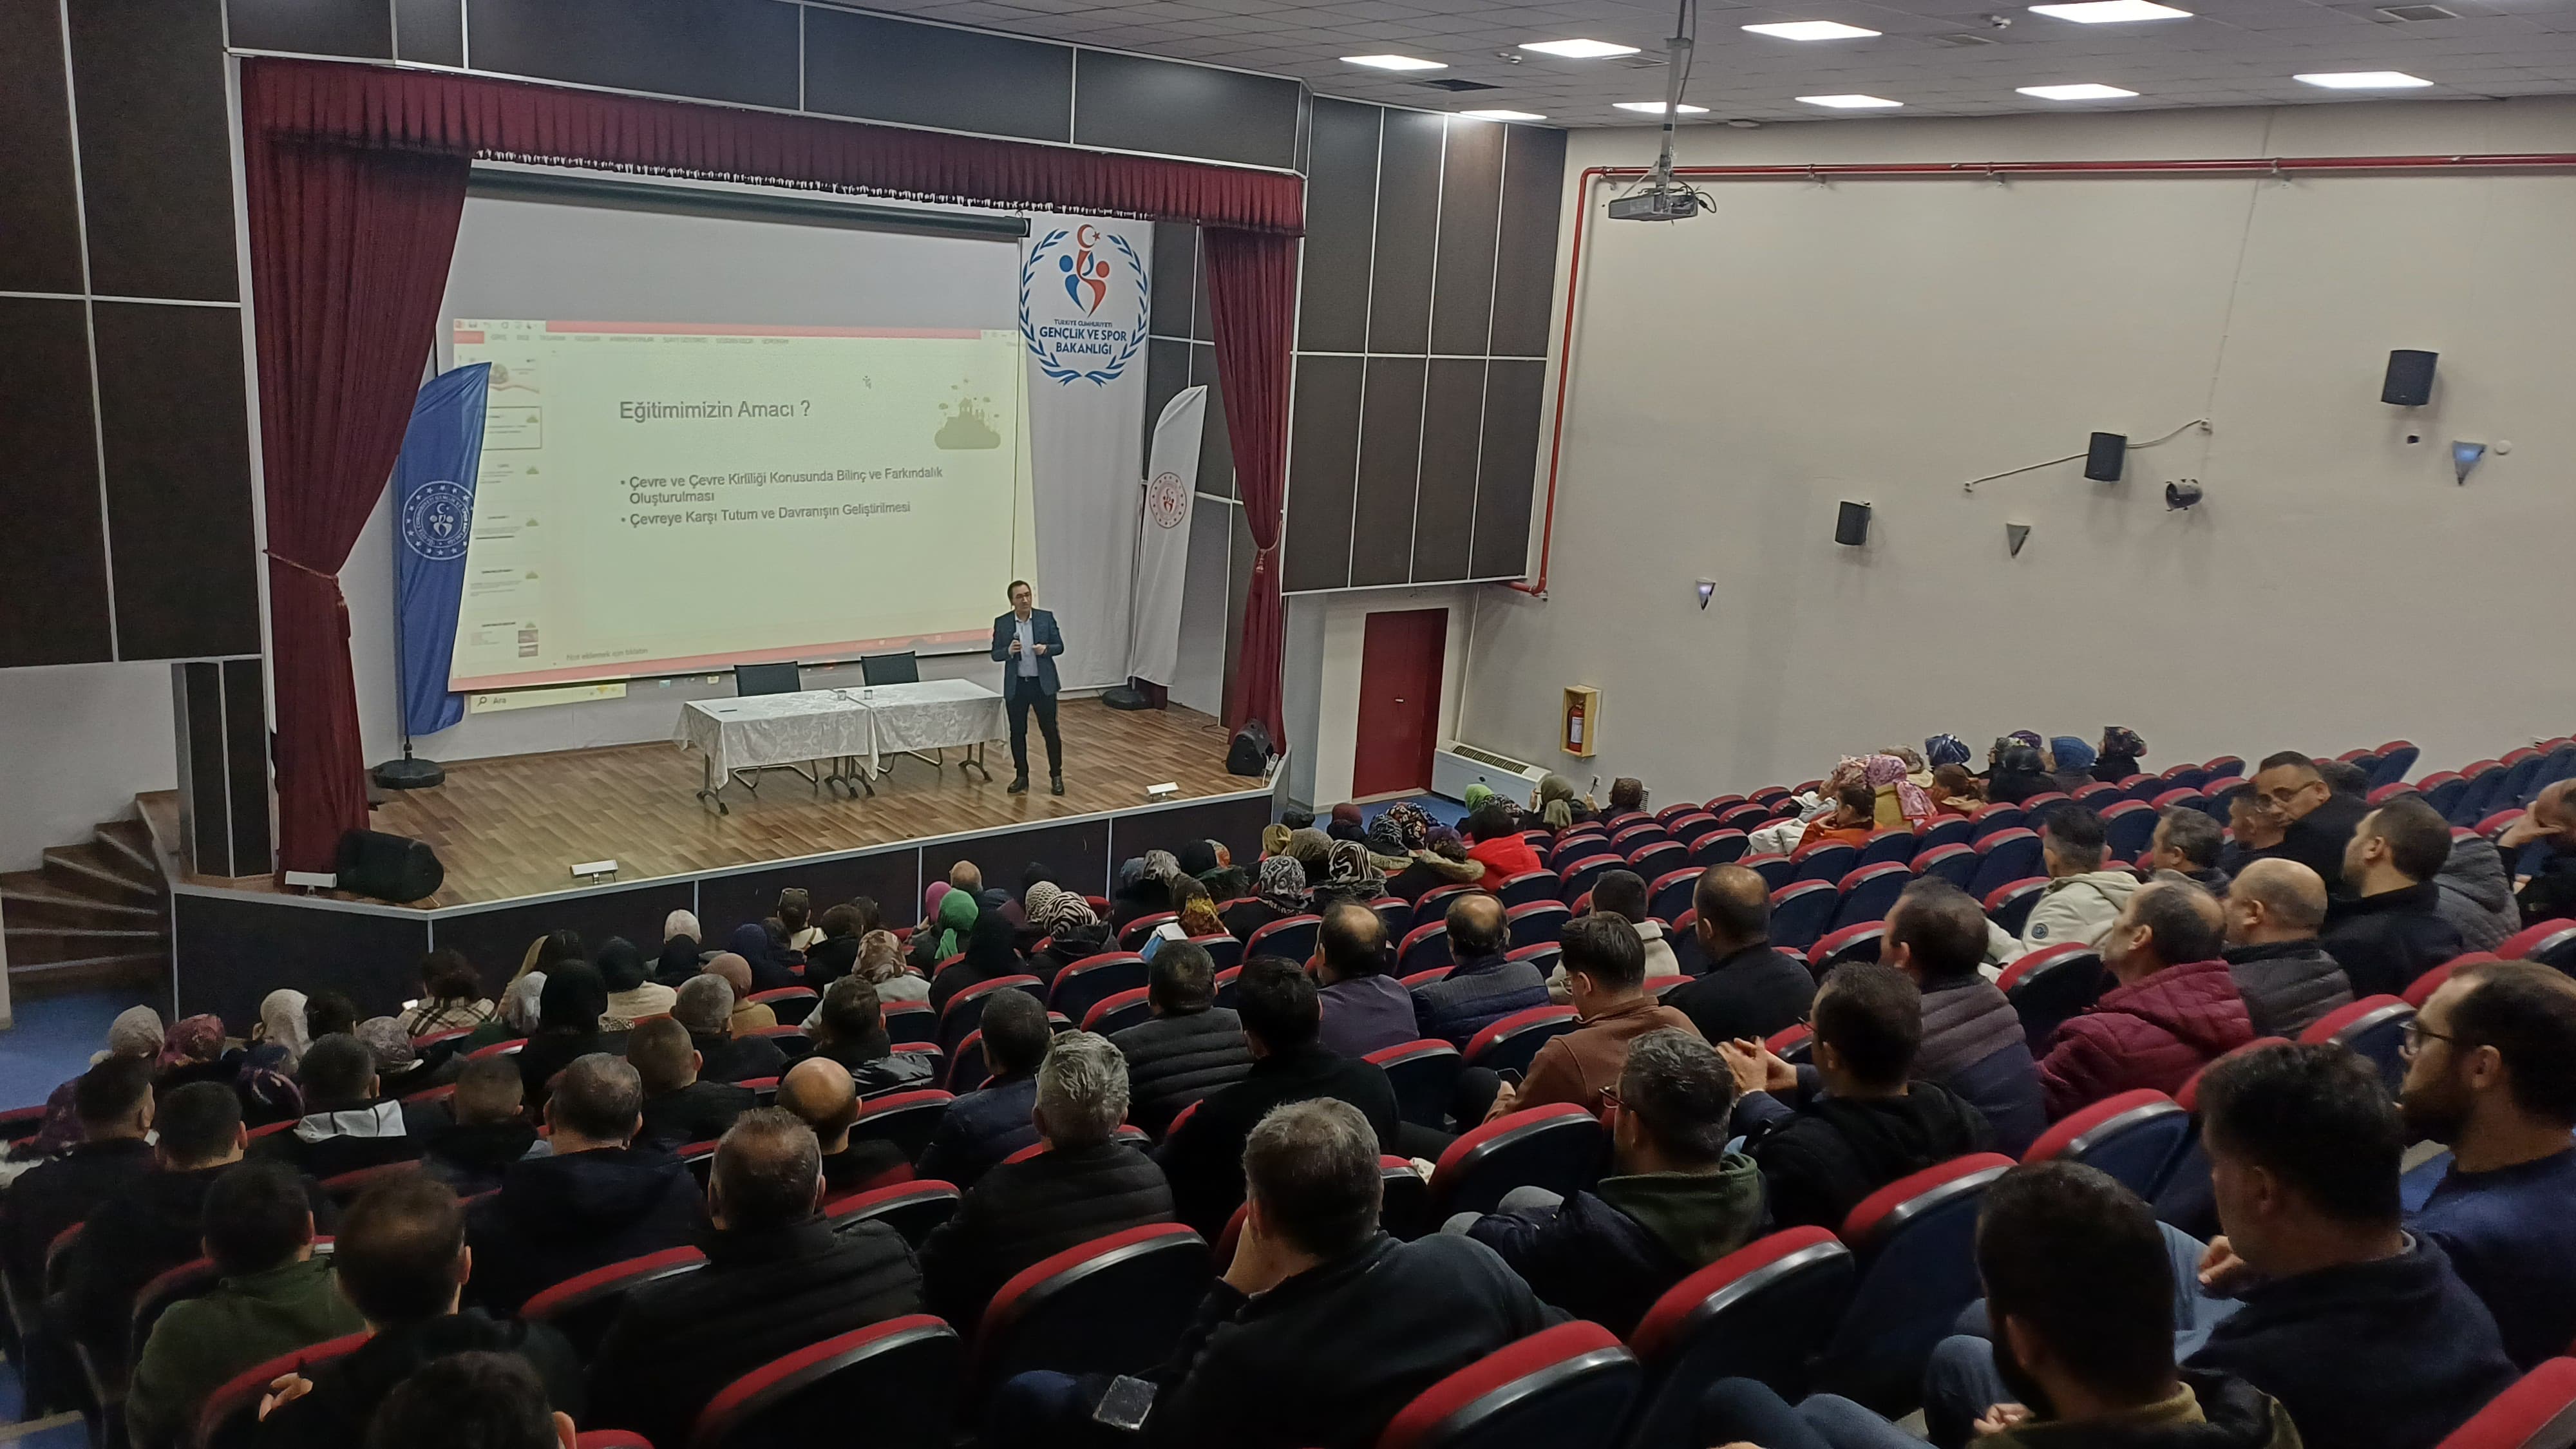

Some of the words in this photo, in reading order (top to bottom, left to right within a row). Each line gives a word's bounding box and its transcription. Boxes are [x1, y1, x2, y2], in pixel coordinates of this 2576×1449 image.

[1039, 326, 1084, 340] GENÇLİK
[1087, 329, 1099, 340] VE
[1101, 330, 1127, 341] SPOR
[1056, 342, 1112, 355] BAKANLIĞI
[620, 401, 732, 423] Eğitimimizin
[738, 401, 794, 417] Amacı
[800, 400, 810, 417] ?
[630, 477, 667, 491] Çevre
[670, 477, 685, 488] ve
[689, 475, 725, 489] Çevre
[729, 473, 766, 487] Kirliliği
[770, 471, 833, 484] Konusunda
[837, 469, 866, 483] Bilinç
[869, 471, 882, 480] ve
[885, 467, 943, 479] Farkındalık
[630, 491, 715, 506] Oluşturulması
[630, 513, 682, 528] Çevreye
[686, 511, 717, 524] Karşı
[721, 509, 758, 520] Tutum
[761, 509, 775, 518] ve
[779, 506, 839, 519] Davranışın
[842, 502, 911, 516] Geliştirilmesi
